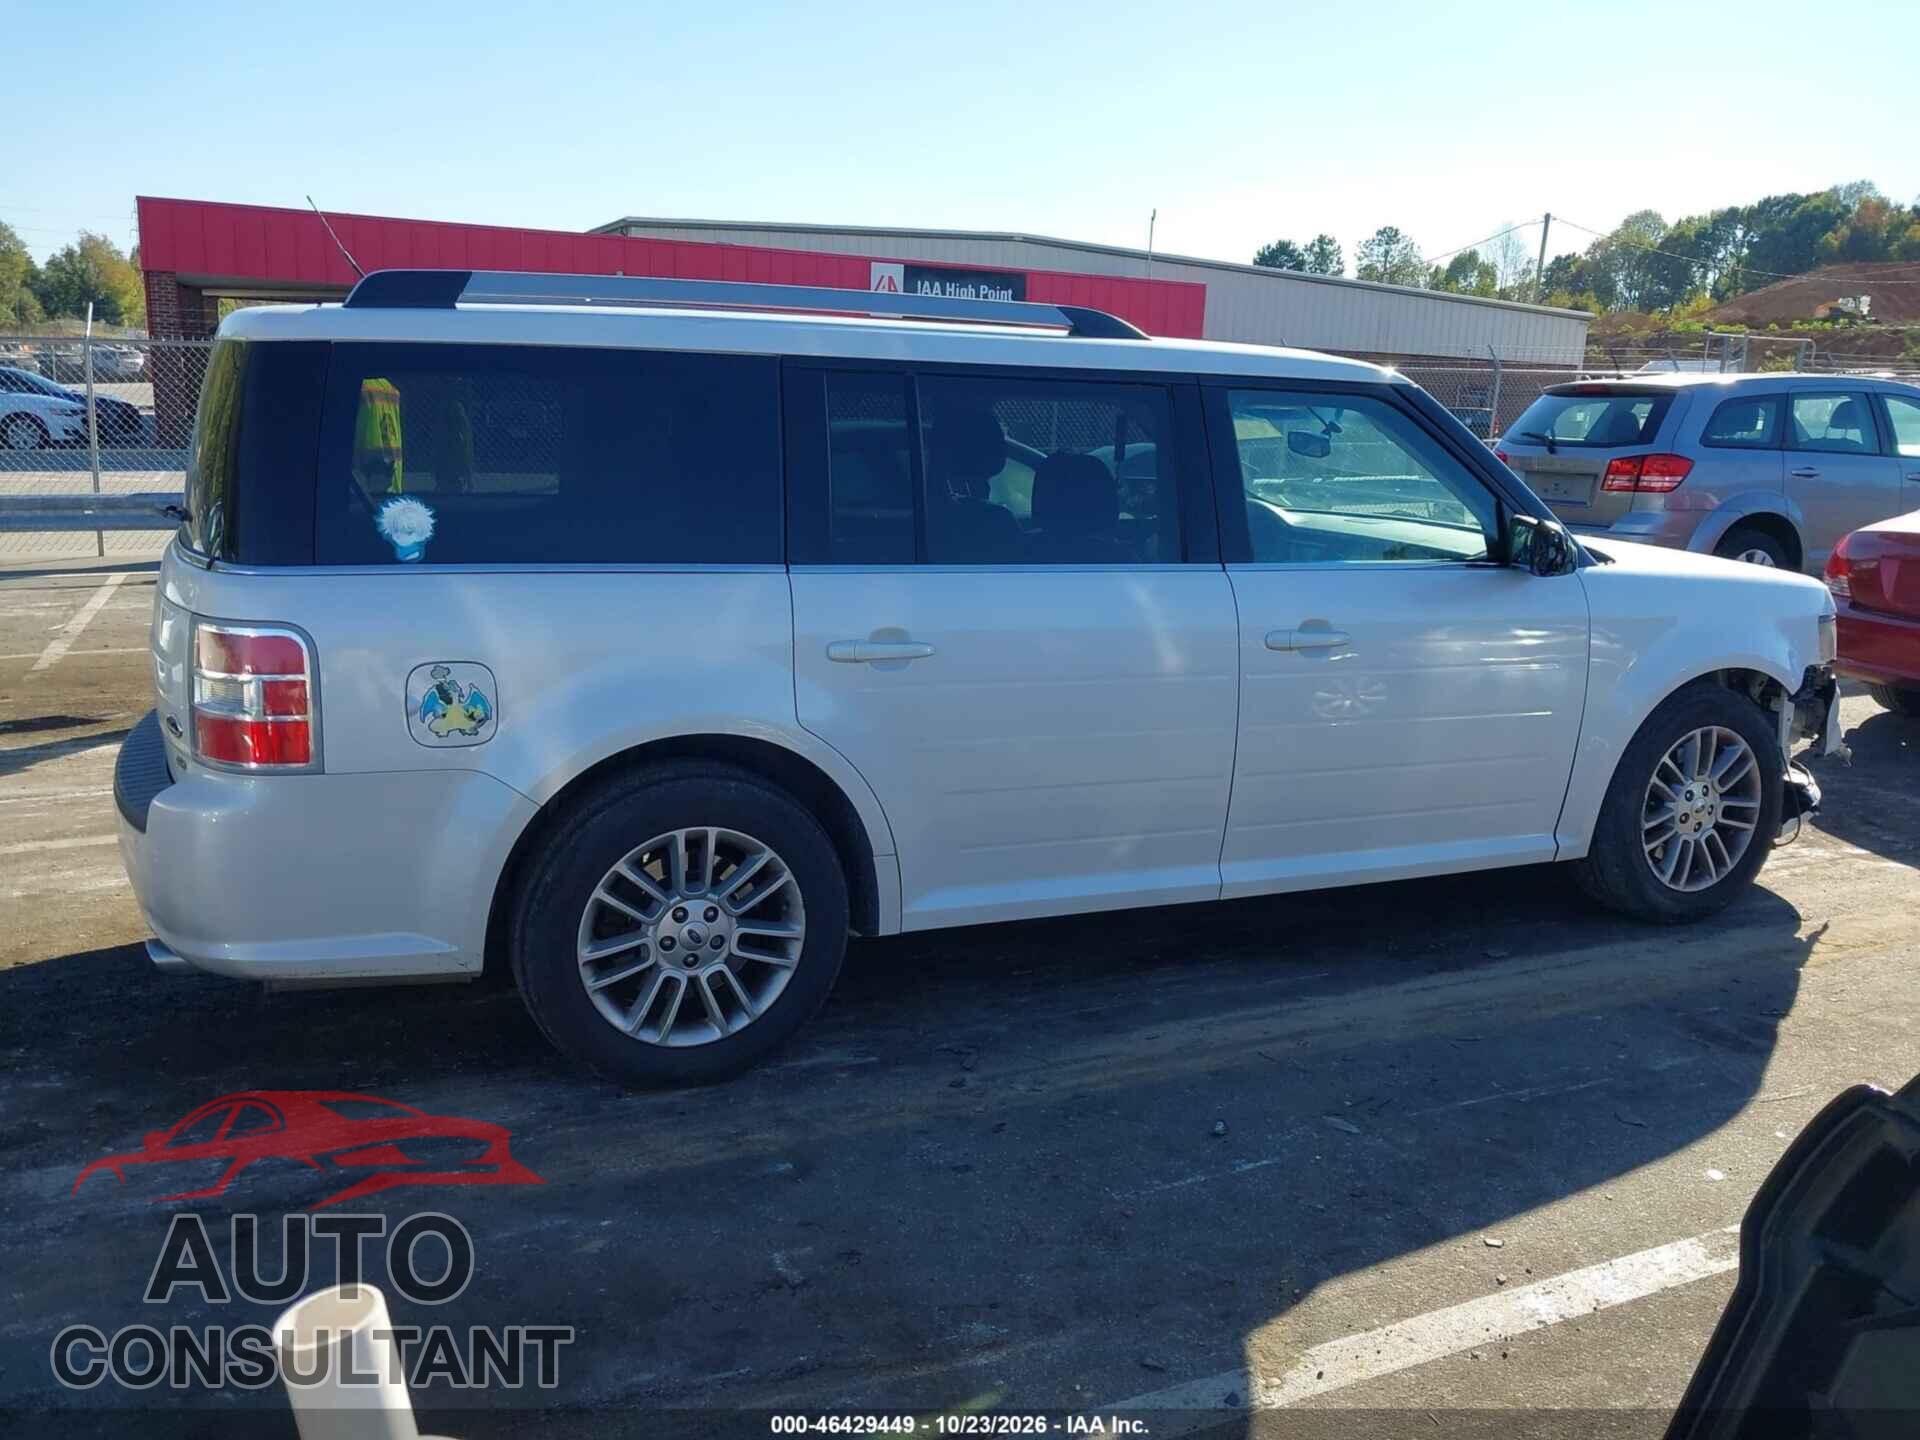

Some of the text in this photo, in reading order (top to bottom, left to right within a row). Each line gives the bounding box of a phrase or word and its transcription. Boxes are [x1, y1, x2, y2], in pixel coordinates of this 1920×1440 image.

[917, 280, 1013, 302] IAA High Point
